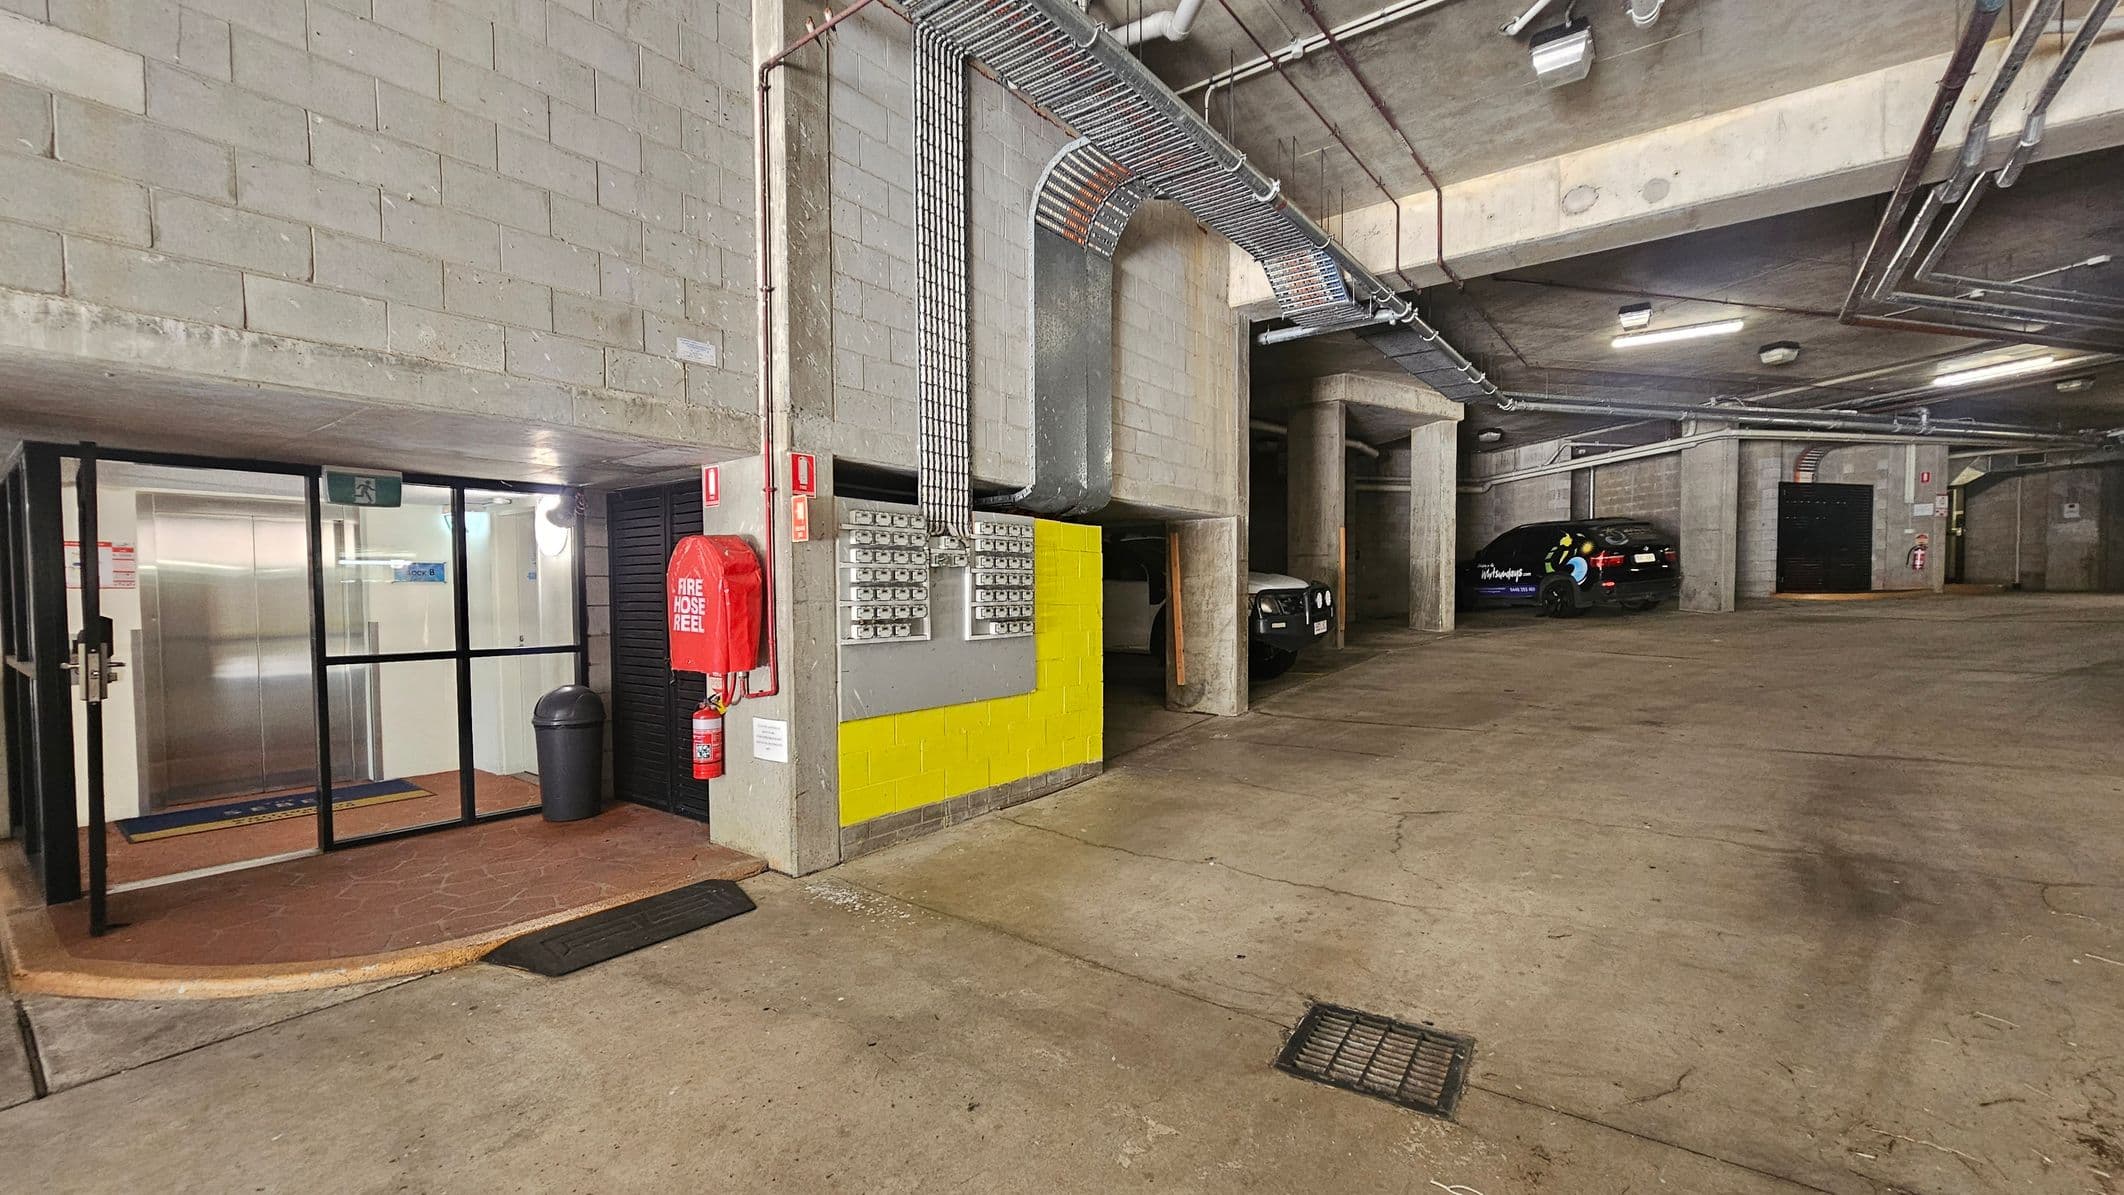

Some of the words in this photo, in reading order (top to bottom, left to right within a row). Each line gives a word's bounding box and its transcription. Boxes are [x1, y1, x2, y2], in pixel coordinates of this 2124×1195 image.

[677, 577, 704, 596] FIRE
[673, 595, 706, 615] HOSE
[673, 613, 705, 633] REEL
